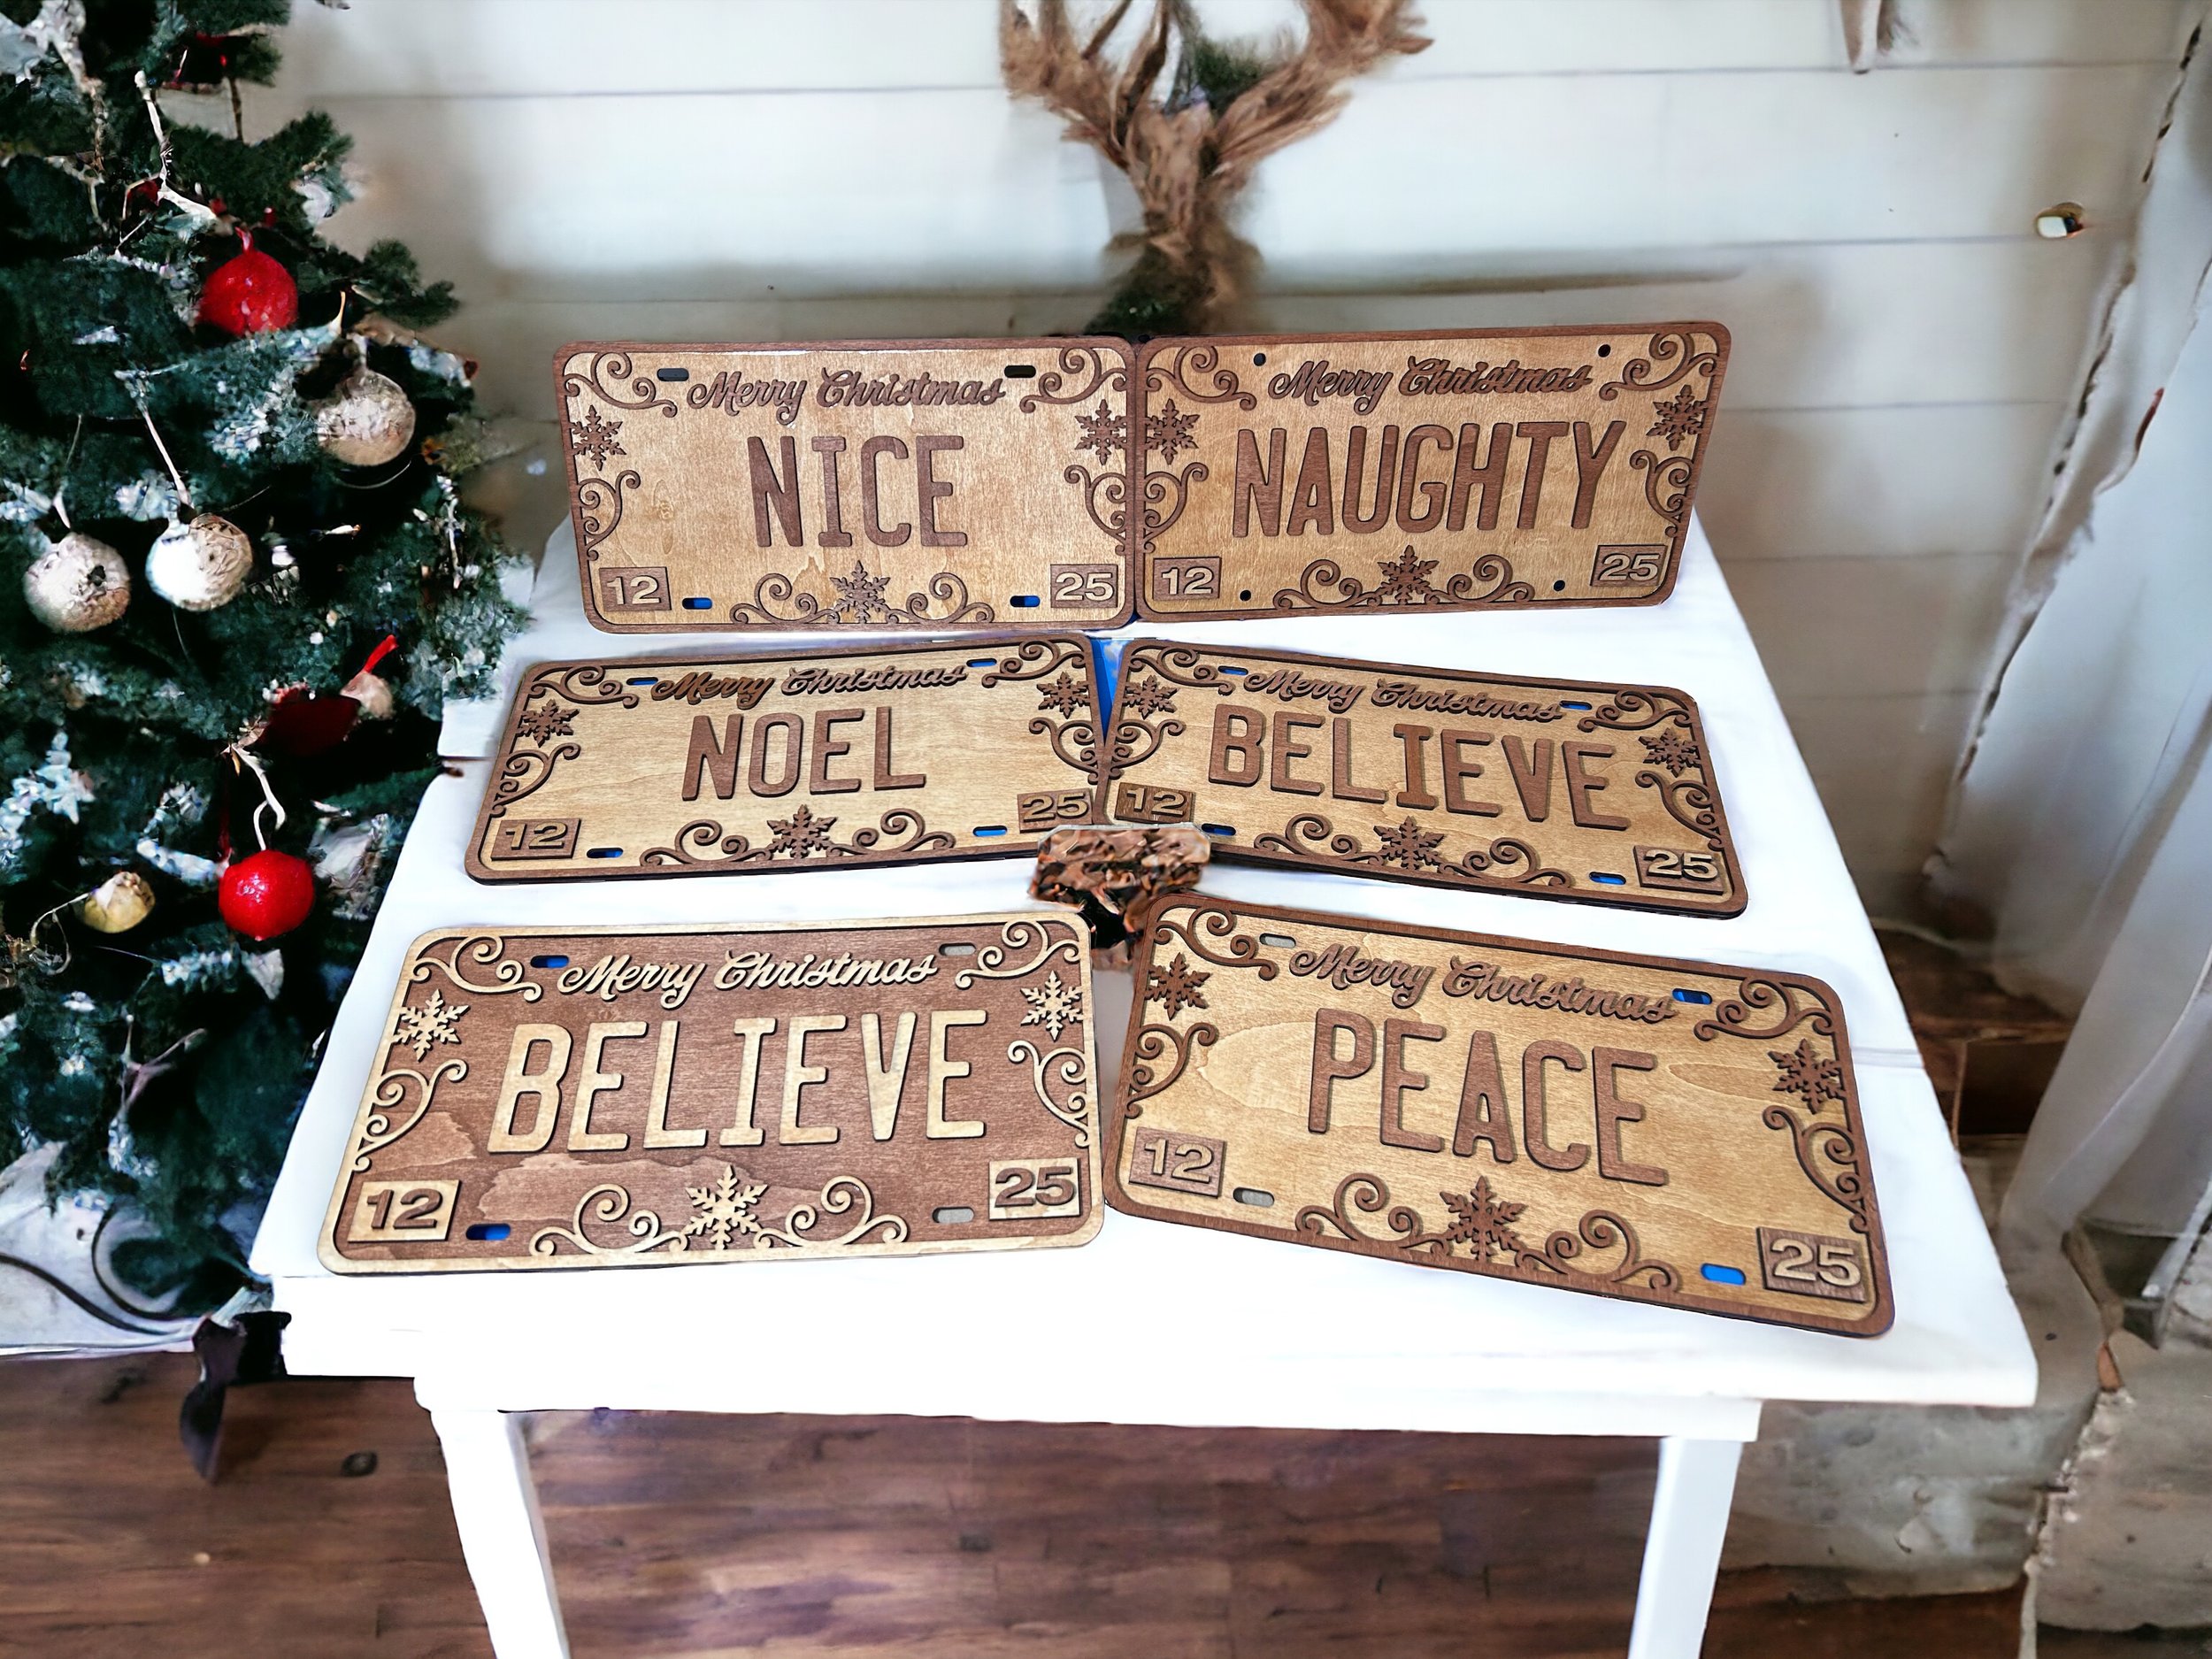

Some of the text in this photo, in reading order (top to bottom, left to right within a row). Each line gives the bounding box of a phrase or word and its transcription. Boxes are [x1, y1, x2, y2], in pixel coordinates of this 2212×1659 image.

[687, 367, 1006, 425] Merry Christmas
[1268, 355, 1593, 415] Merry Christmas
[748, 435, 968, 548] NICE
[1233, 421, 1626, 538] NAUGHTY
[1056, 572, 1114, 602] 25
[1162, 565, 1214, 595] 12
[1597, 552, 1660, 581] 25
[606, 575, 662, 606] 12
[654, 662, 970, 708] Merry Christmas
[1242, 670, 1569, 721] Merry Christmas
[682, 706, 926, 801] NOEL
[1208, 703, 1631, 830] BELIEVE
[1022, 794, 1088, 821] 25
[1126, 787, 1187, 817] 12
[504, 823, 568, 851] 12
[1646, 850, 1717, 881] 25
[562, 950, 938, 1010] Merry Christmas
[1290, 943, 1679, 1024] Merry Christmas
[488, 1010, 987, 1155] BELIEVE
[1308, 1007, 1668, 1187] PEACE
[1143, 1137, 1215, 1181] 12
[366, 1187, 446, 1230] 12
[993, 1166, 1077, 1207] 25
[1771, 1239, 1863, 1288] 25
